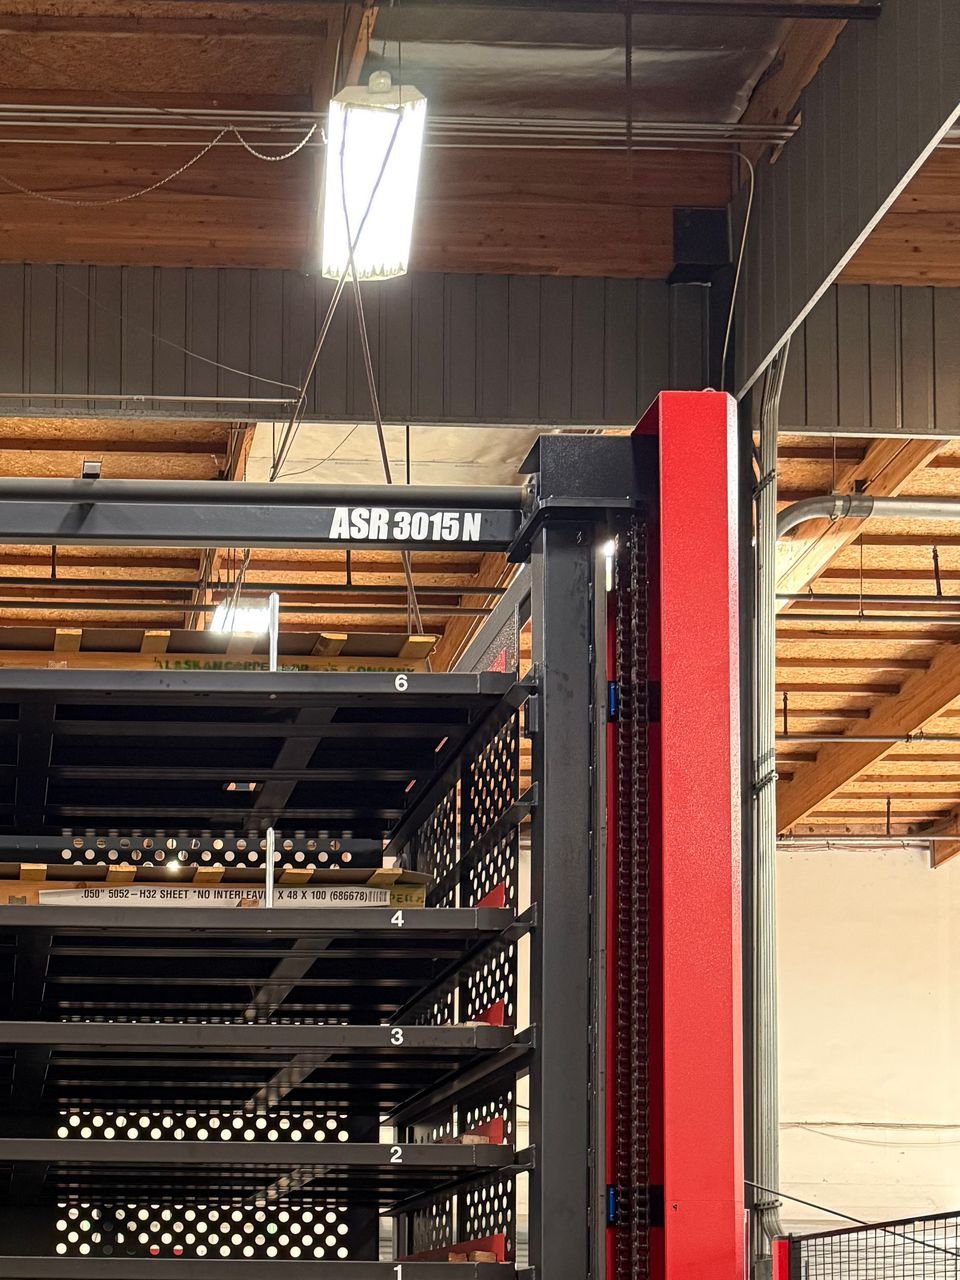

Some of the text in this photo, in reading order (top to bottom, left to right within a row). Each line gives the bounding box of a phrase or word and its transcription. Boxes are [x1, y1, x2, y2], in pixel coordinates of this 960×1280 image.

[328, 507, 389, 540] ASR
[394, 674, 408, 691] 6
[81, 890, 105, 899] .050"
[160, 890, 189, 899] SHEET
[277, 891, 285, 900] X
[287, 891, 298, 900] 48
[301, 891, 308, 900] X
[311, 891, 327, 900] 100
[329, 890, 368, 901] (686678)
[390, 911, 404, 927] 4
[390, 1028, 404, 1045] 3
[390, 1146, 403, 1163] 2
[393, 1265, 402, 1280] 1
